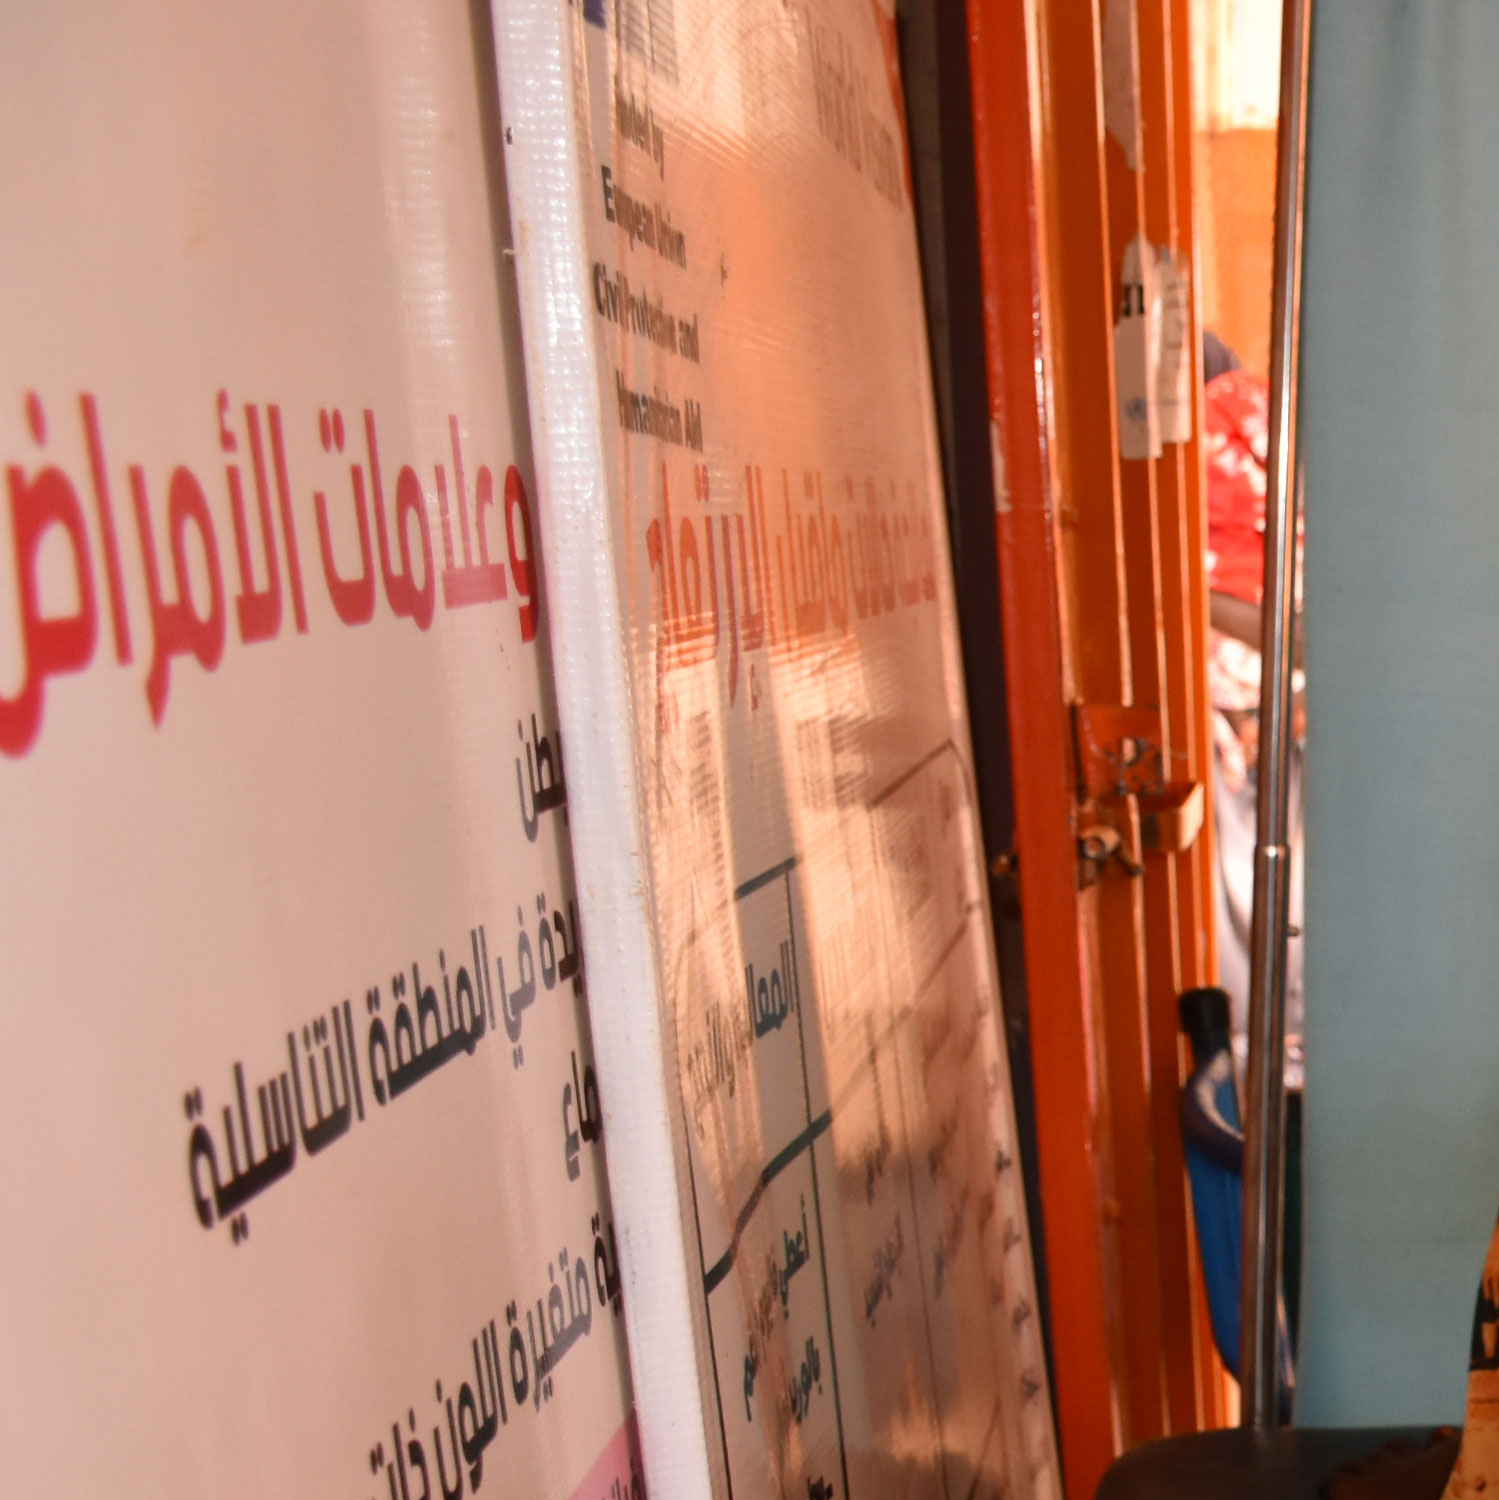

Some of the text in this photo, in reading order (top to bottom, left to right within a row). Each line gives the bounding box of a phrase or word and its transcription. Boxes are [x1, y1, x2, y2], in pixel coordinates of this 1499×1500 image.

[183, 892, 584, 1246] يدة في المنطقة التناسلية
[563, 1050, 602, 1182] ماع
[506, 1247, 592, 1413] متغيرة
